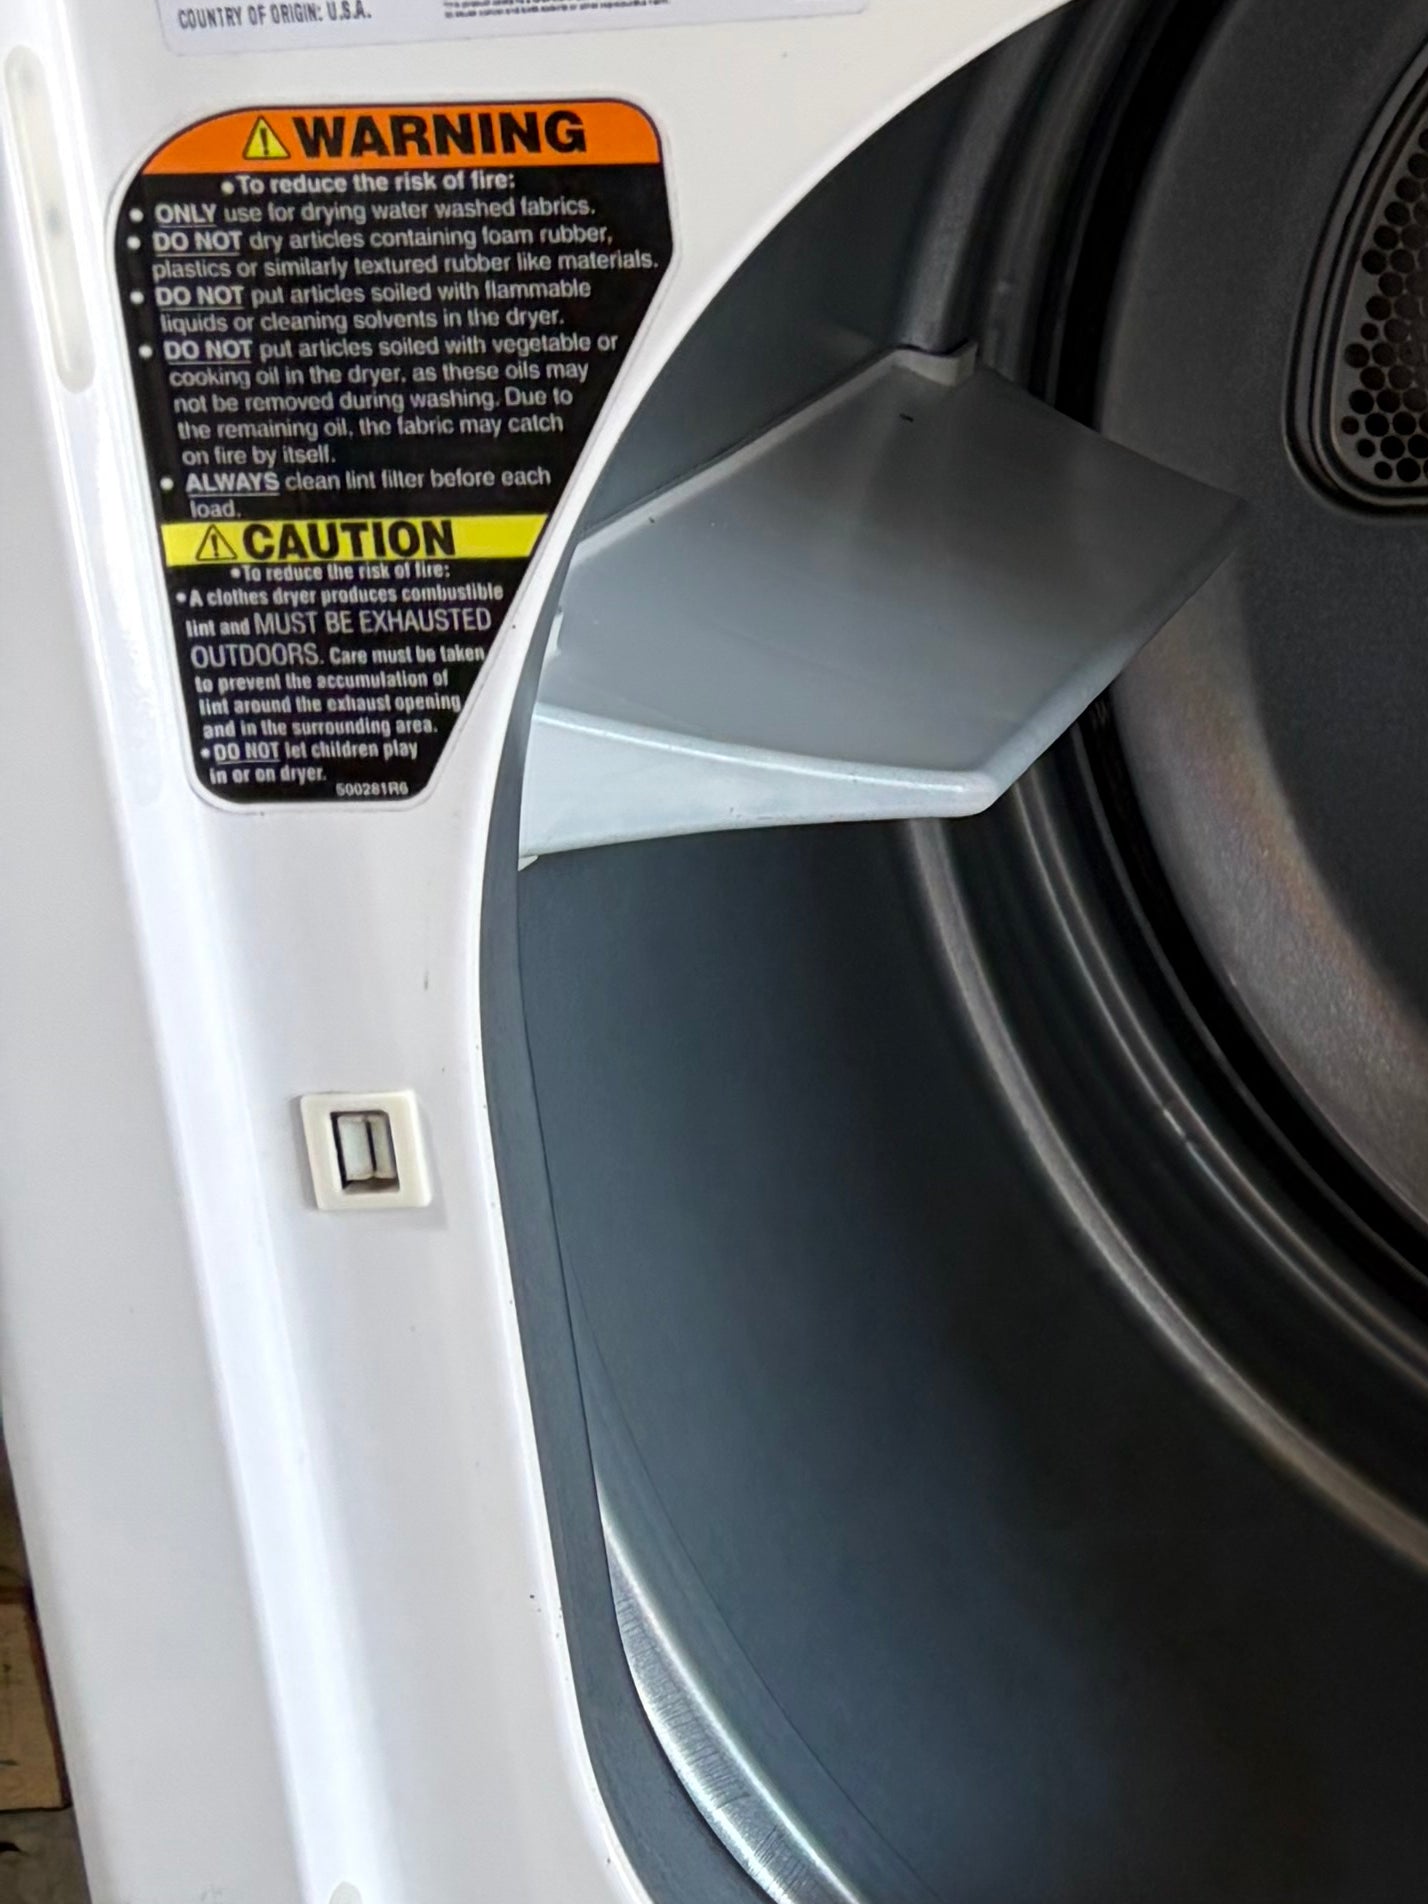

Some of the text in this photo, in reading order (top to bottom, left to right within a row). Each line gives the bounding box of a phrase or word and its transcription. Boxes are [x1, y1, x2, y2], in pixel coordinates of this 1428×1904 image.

[178, 5, 242, 30] COUNTRY
[249, 3, 267, 27] OF
[271, 0, 323, 25] ORIGIN:
[293, 110, 586, 157] WARNING
[270, 174, 347, 194] reduce
[353, 173, 388, 192] the
[395, 171, 437, 192] risk
[443, 171, 465, 190] of
[471, 170, 515, 189] fire:
[155, 196, 596, 225] ONLY use for drying water washed fabrics.
[153, 225, 613, 253] DO NOT dry articles containing foam rubber,
[153, 249, 658, 282] plastics or similarly textured rubber like materials.
[186, 466, 551, 493] ALWAYS clean lint filter before each
[190, 499, 241, 518] load.
[243, 520, 456, 560] CAUTION
[186, 607, 492, 638] lint and MUST BE EXHAUSTED
[191, 643, 485, 669] OUTDOORS. Care must be taken
[214, 739, 417, 762] DO NOT let children play
[210, 765, 327, 785] in or on dryer.
